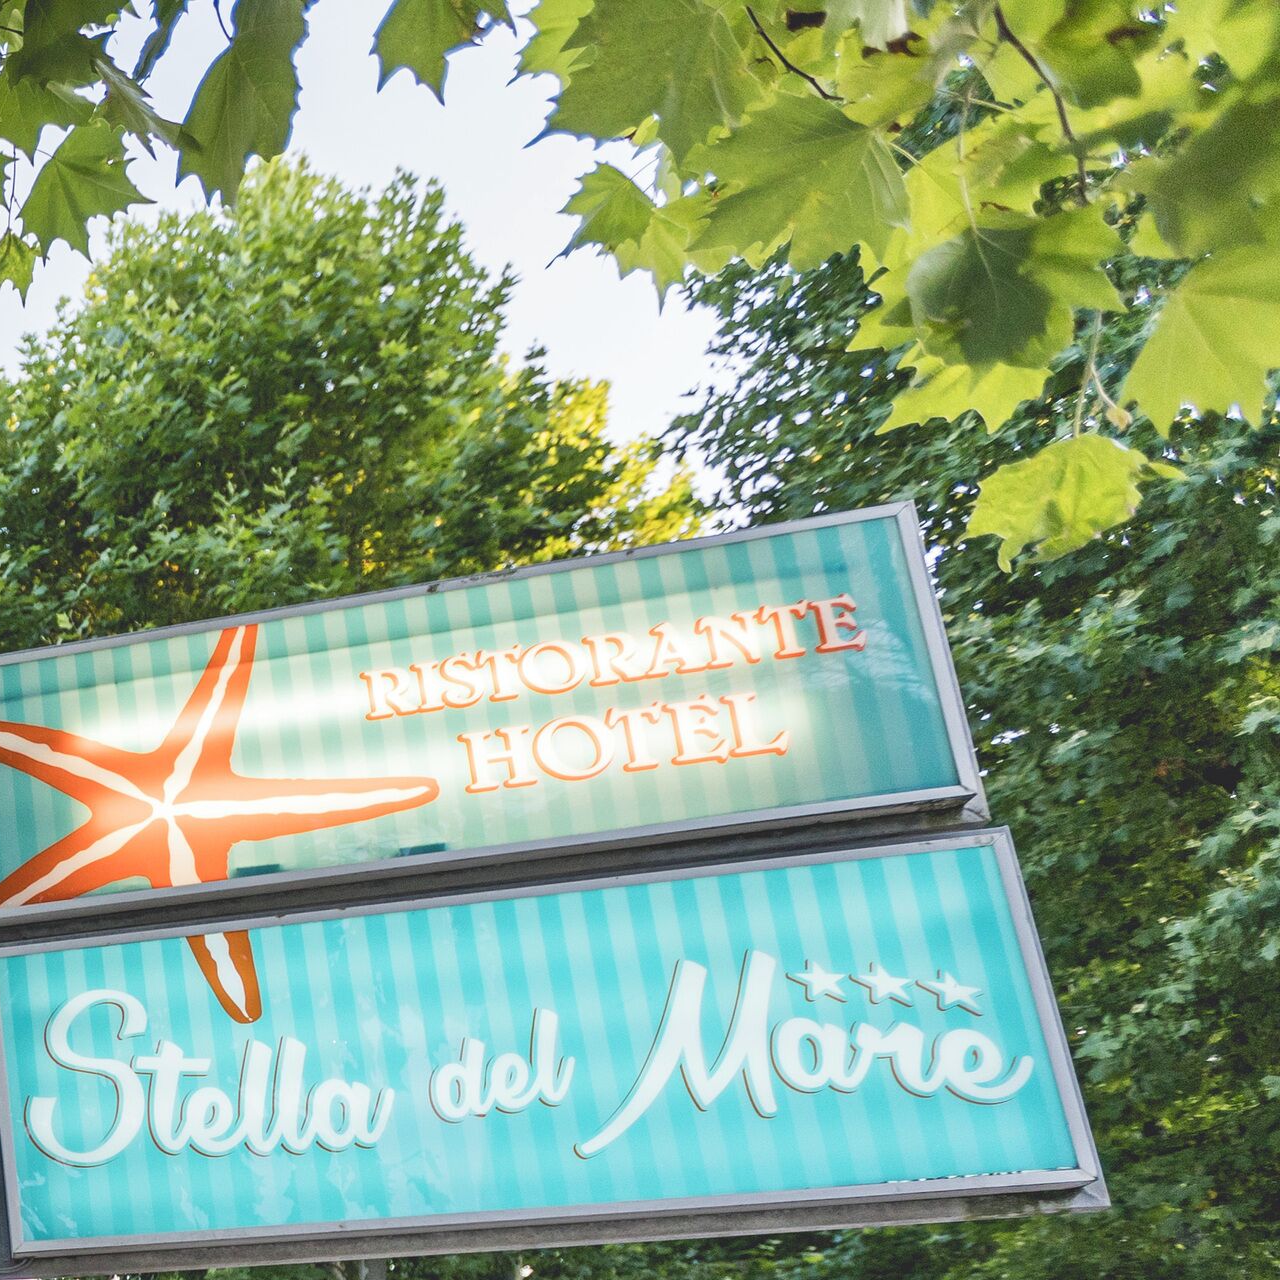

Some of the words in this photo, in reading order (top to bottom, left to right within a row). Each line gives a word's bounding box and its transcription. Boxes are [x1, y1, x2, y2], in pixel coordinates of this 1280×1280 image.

[359, 592, 868, 721] RISTORANTE
[457, 693, 791, 794] HOTEL
[24, 988, 396, 1169] Stella
[428, 1007, 576, 1124] del
[573, 948, 1036, 1160] Mare
